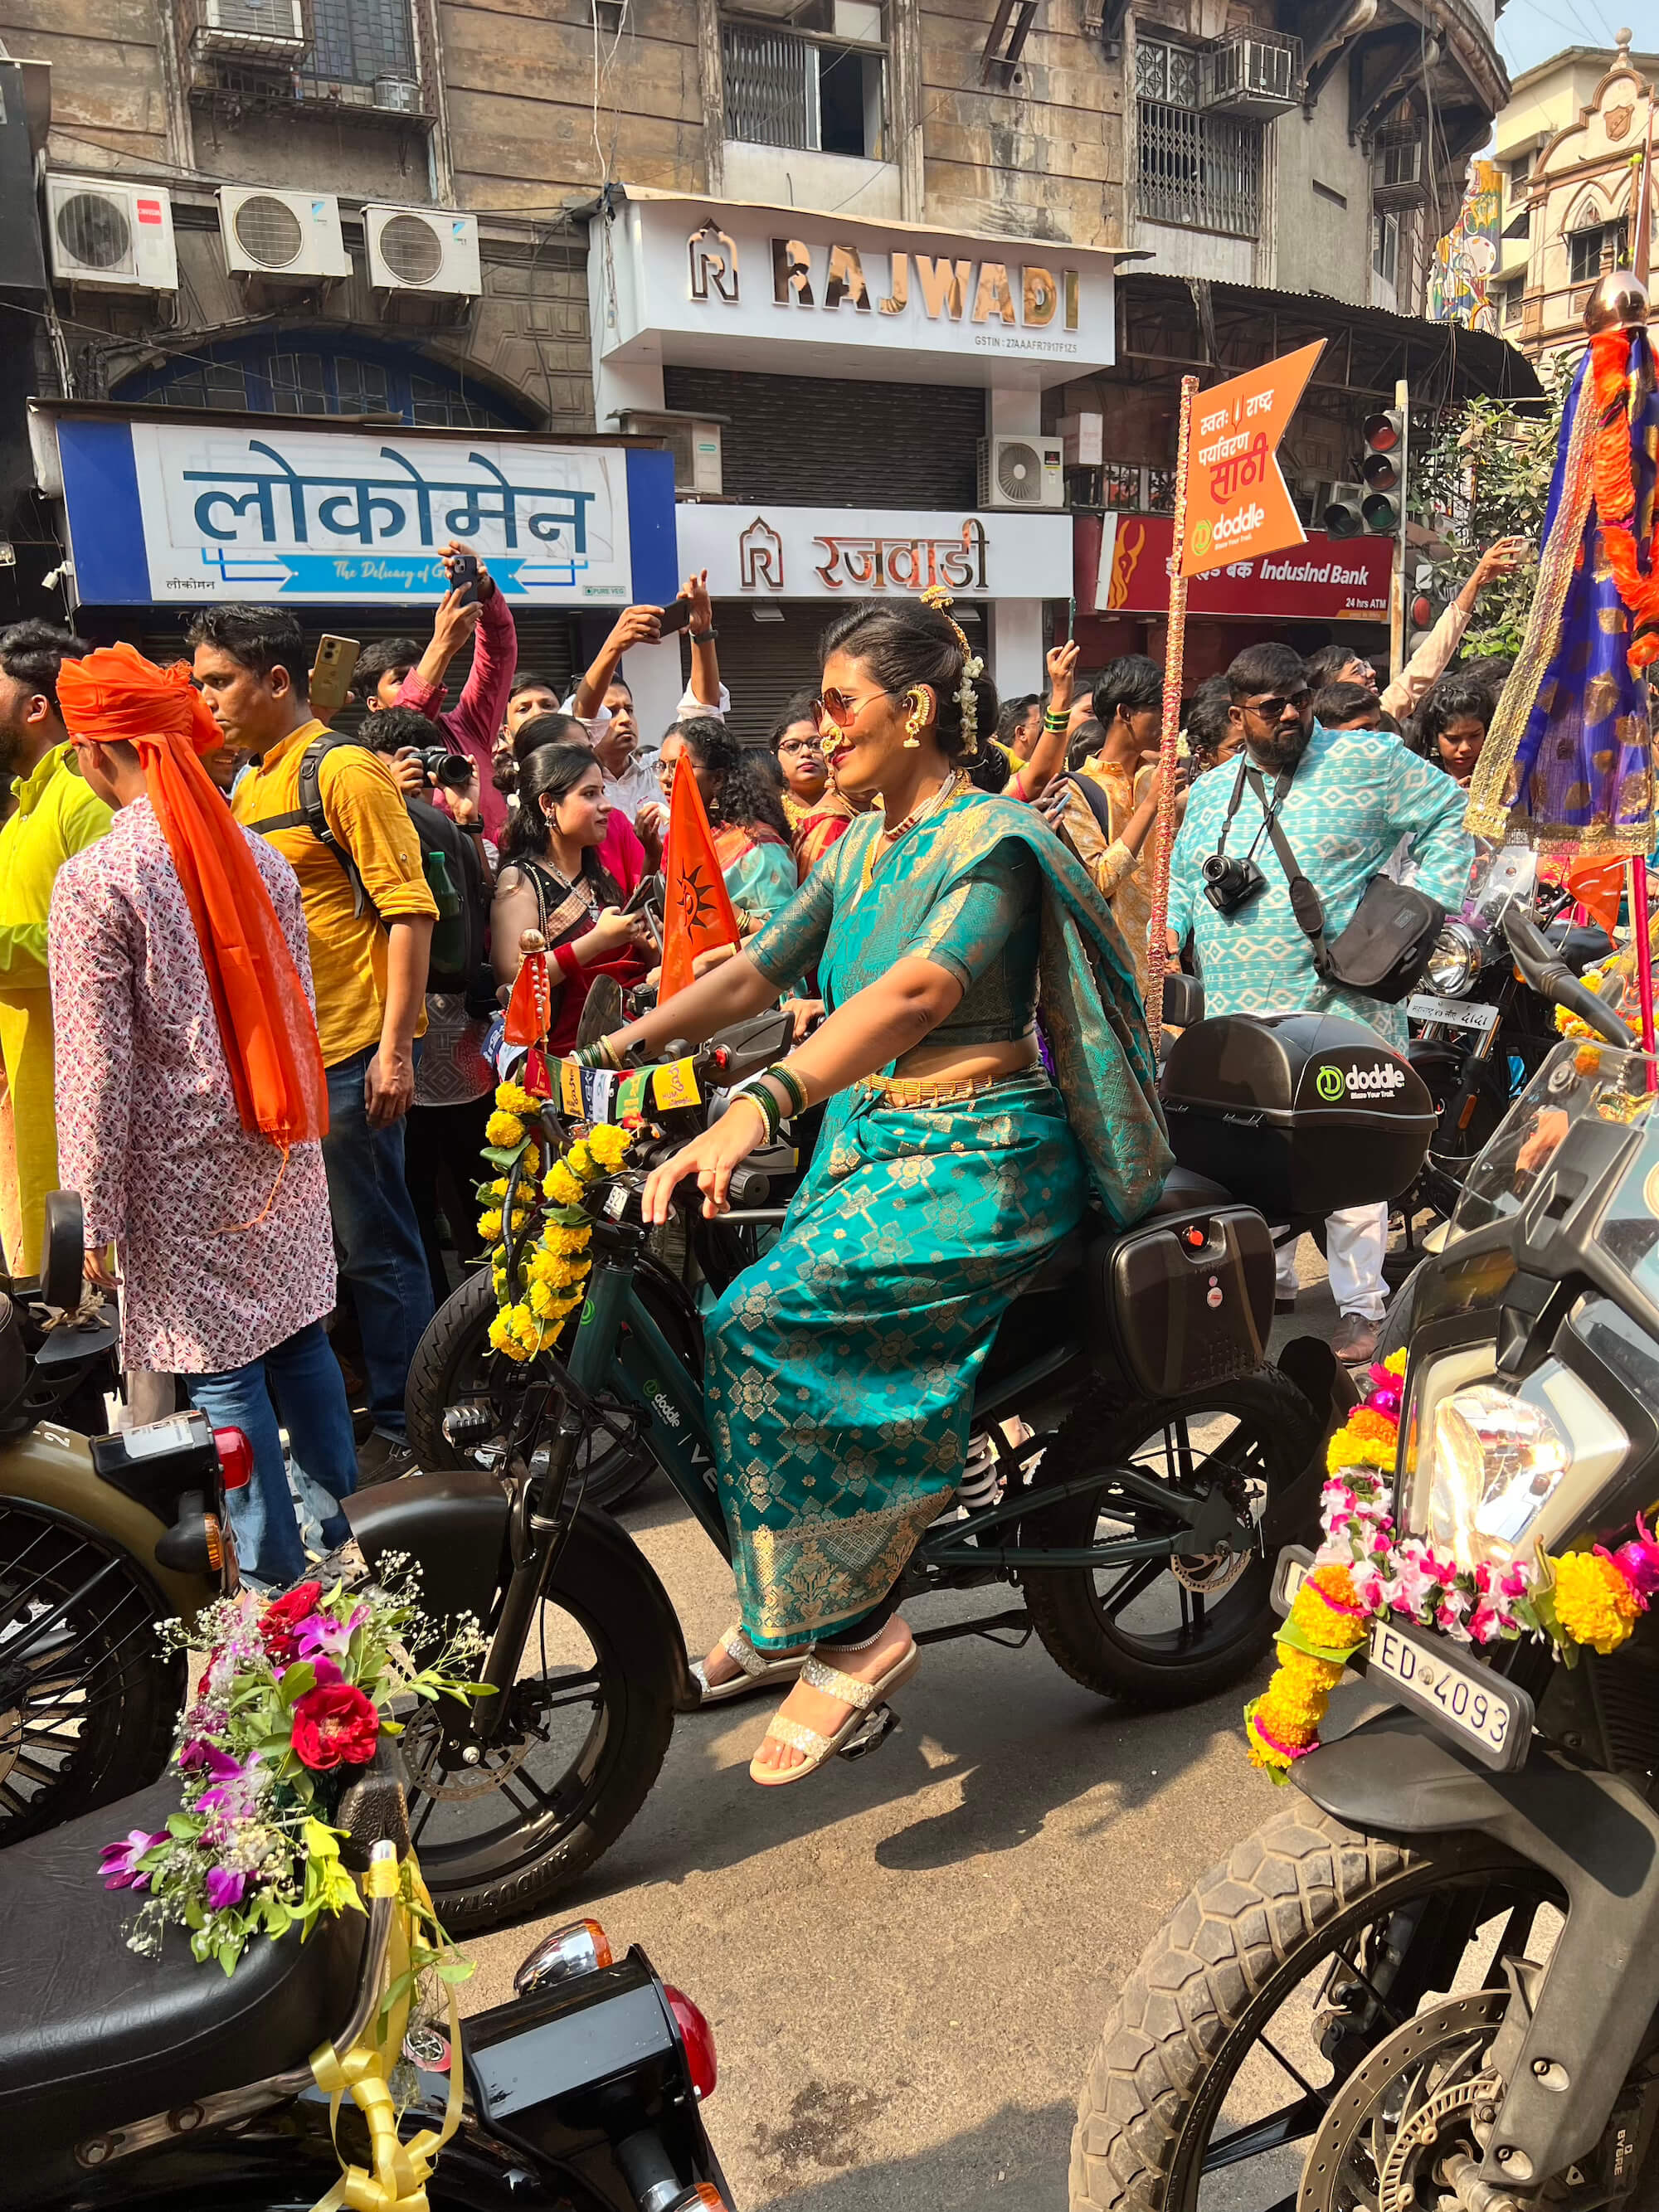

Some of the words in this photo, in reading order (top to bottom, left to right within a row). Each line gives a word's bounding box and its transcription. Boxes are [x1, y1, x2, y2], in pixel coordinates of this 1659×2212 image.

[771, 238, 1078, 331] RAJWADI
[975, 335, 1000, 348] GSTIN
[1200, 408, 1229, 436] स्वतः
[1246, 388, 1275, 417] राष्ट्र
[1209, 431, 1269, 505] साठी
[182, 440, 596, 554] लोकोमेन
[1213, 502, 1265, 541] doddle
[333, 560, 357, 581] The
[416, 563, 429, 584] of
[812, 518, 990, 591] रजवाडी
[1260, 559, 1330, 583] IndusInd
[1331, 565, 1370, 586] Bank
[1345, 597, 1355, 608] 24
[1356, 598, 1369, 609] hrs
[1370, 598, 1387, 610] ATM
[1345, 1062, 1405, 1091] doddle
[654, 1393, 681, 1428] doddle
[1433, 1674, 1507, 1743] 4093
